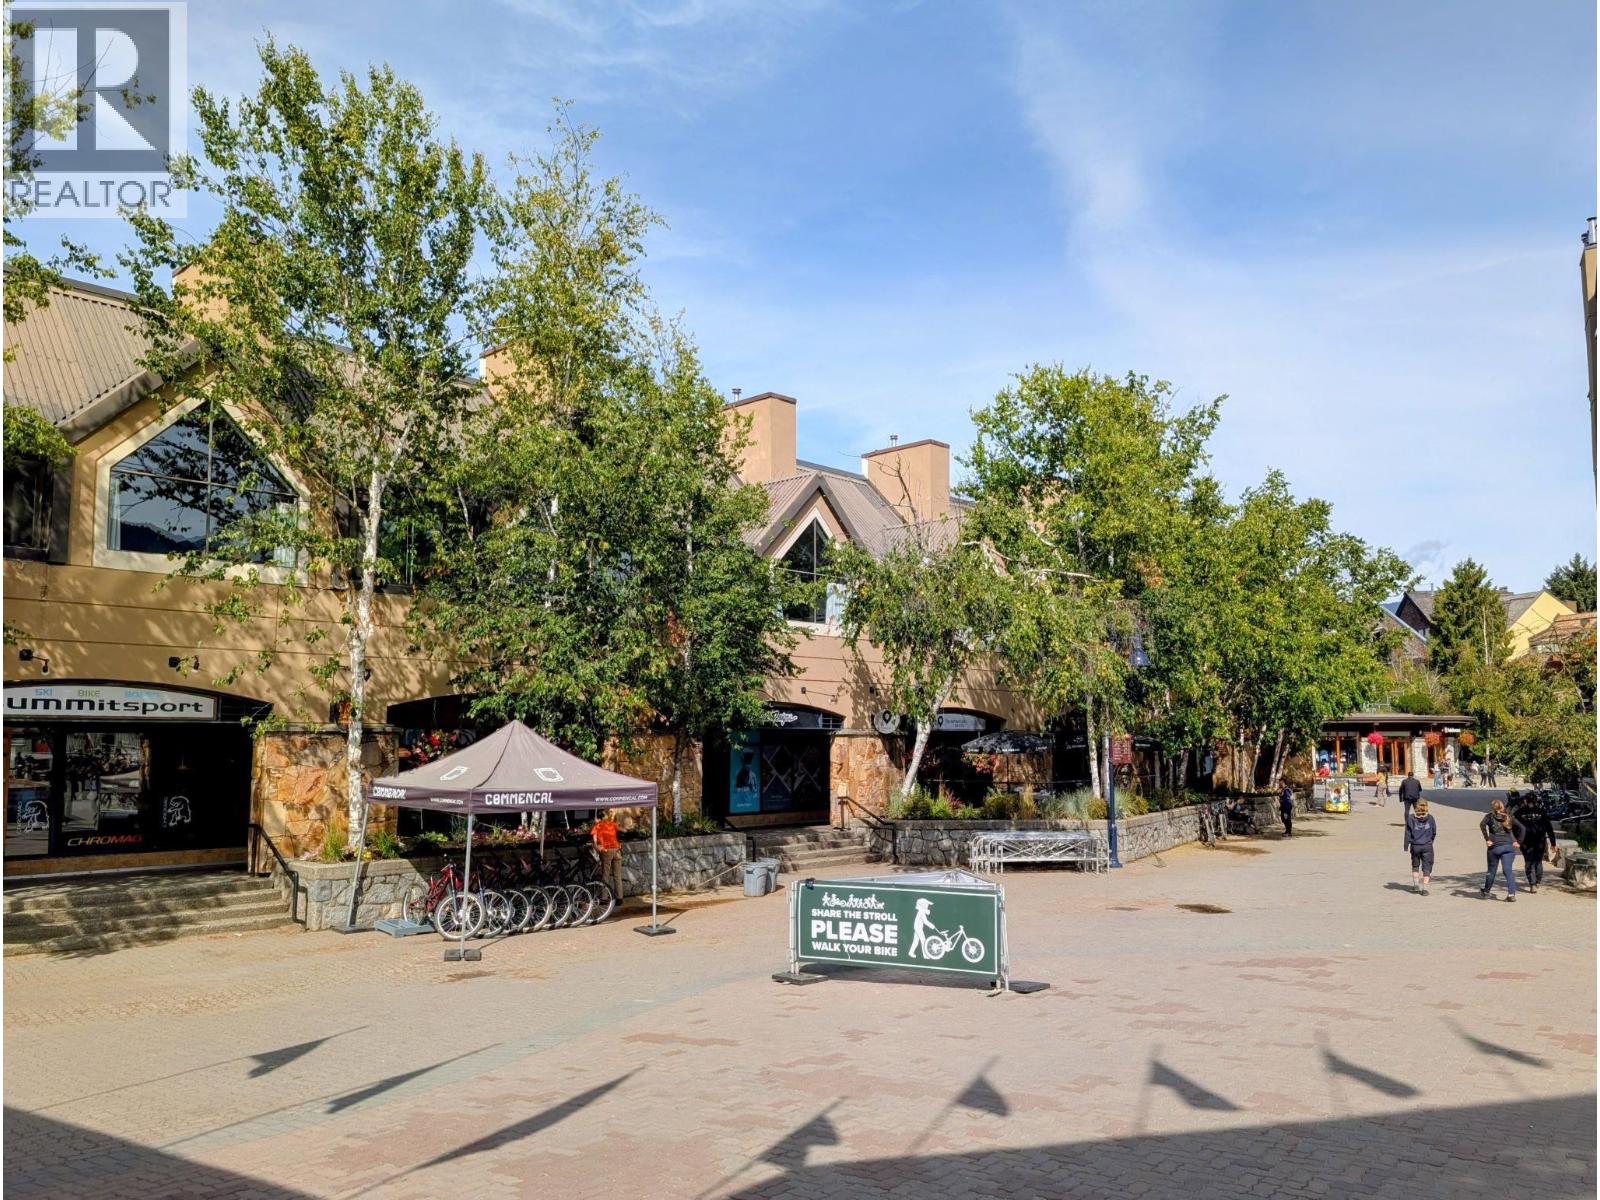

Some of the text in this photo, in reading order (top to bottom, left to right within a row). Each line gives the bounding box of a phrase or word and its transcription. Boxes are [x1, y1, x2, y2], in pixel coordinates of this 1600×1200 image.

[35, 688, 101, 697] SKI BIKE
[3, 697, 203, 715] ummitsport
[485, 792, 554, 805] COMMENCAL
[67, 834, 143, 847] CHROMAG
[811, 908, 898, 922] SHARE THE STROLL
[811, 920, 898, 944] PLEASE
[812, 941, 898, 957] WALK YOUR BIKE
